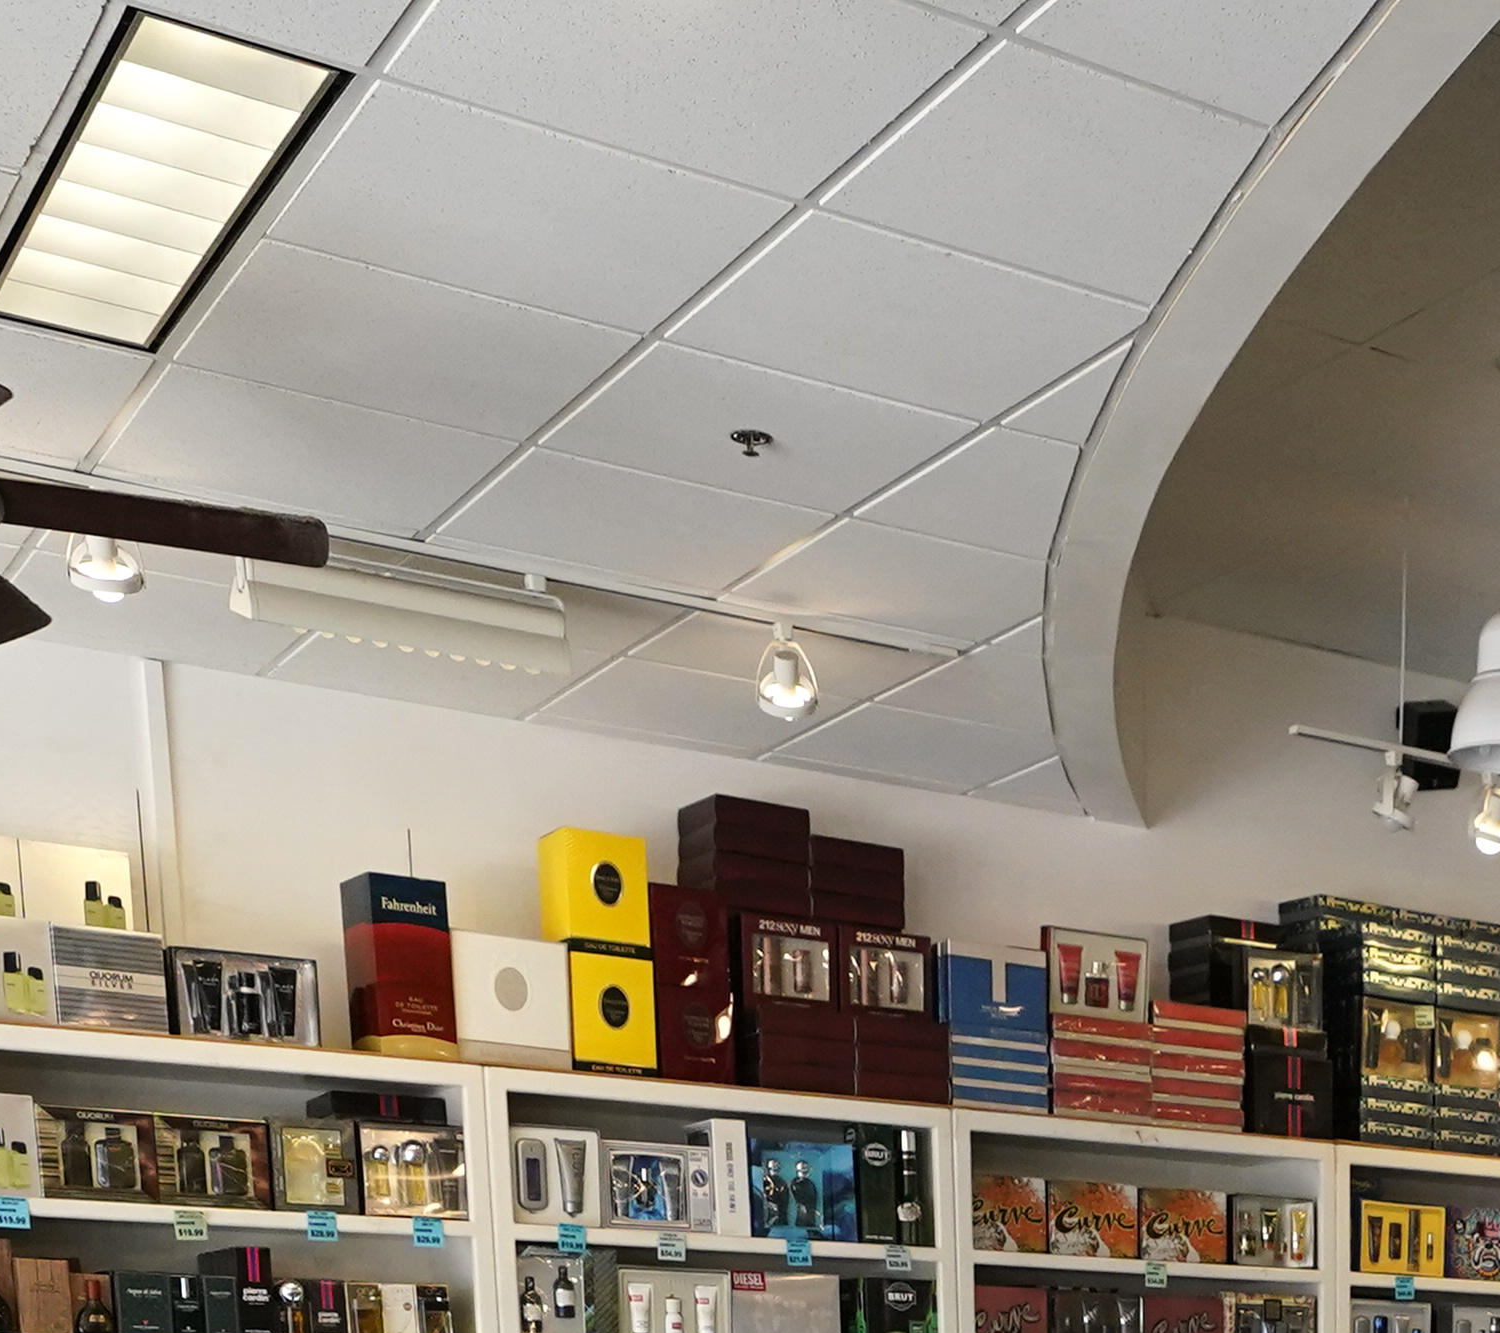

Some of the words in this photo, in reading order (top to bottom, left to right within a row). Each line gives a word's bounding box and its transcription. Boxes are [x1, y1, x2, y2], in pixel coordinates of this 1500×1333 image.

[381, 896, 437, 917] Fahrenheit
[759, 919, 776, 931] 212
[800, 924, 821, 937] MEN
[856, 931, 874, 944] 212
[895, 936, 916, 949] MEN
[89, 970, 134, 983] QUORUM
[1055, 1204, 1135, 1234] Curve
[1146, 1212, 1224, 1239] Curve
[732, 1272, 764, 1286] DIESEL
[887, 1291, 915, 1303] BRUT
